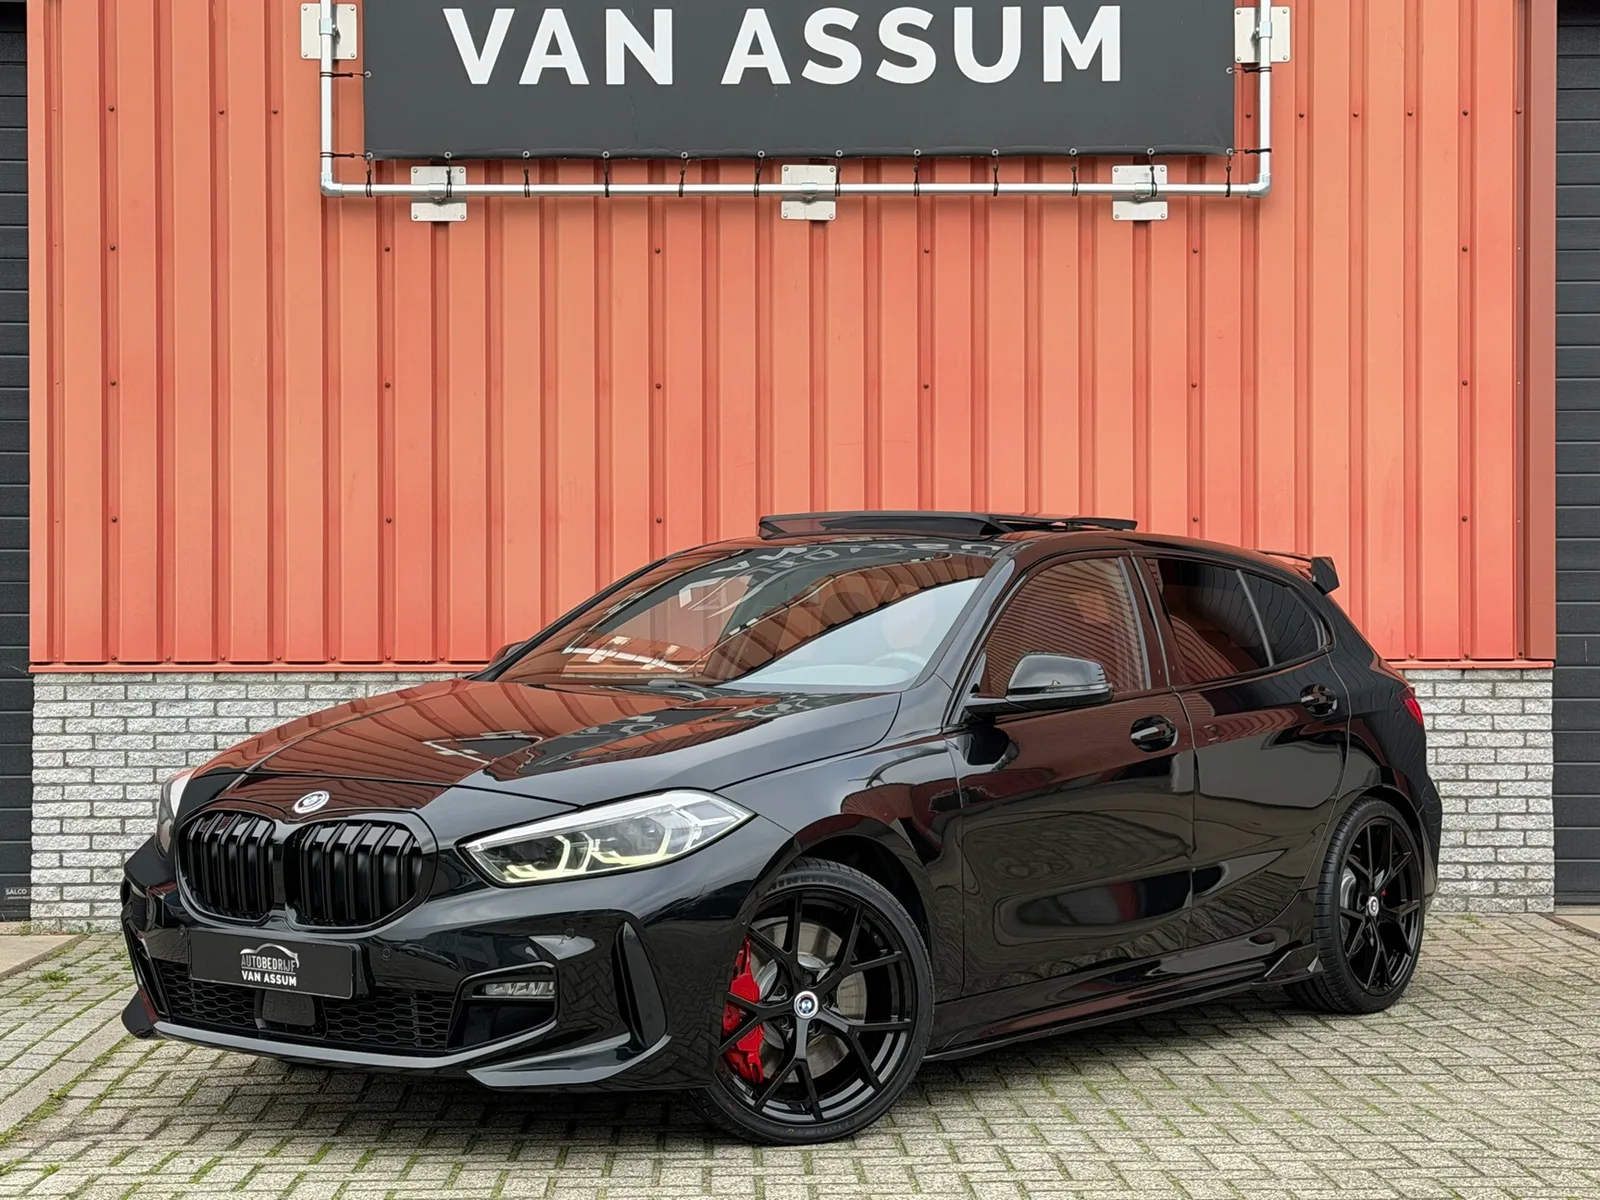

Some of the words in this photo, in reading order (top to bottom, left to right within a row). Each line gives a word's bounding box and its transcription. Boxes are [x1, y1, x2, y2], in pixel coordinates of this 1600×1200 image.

[443, 8, 674, 86] VAN
[721, 5, 1122, 85] ASSUM
[241, 954, 296, 971] AUTOBEDRIJF
[241, 970, 261, 982] VAN
[263, 973, 297, 987] ASSUM
